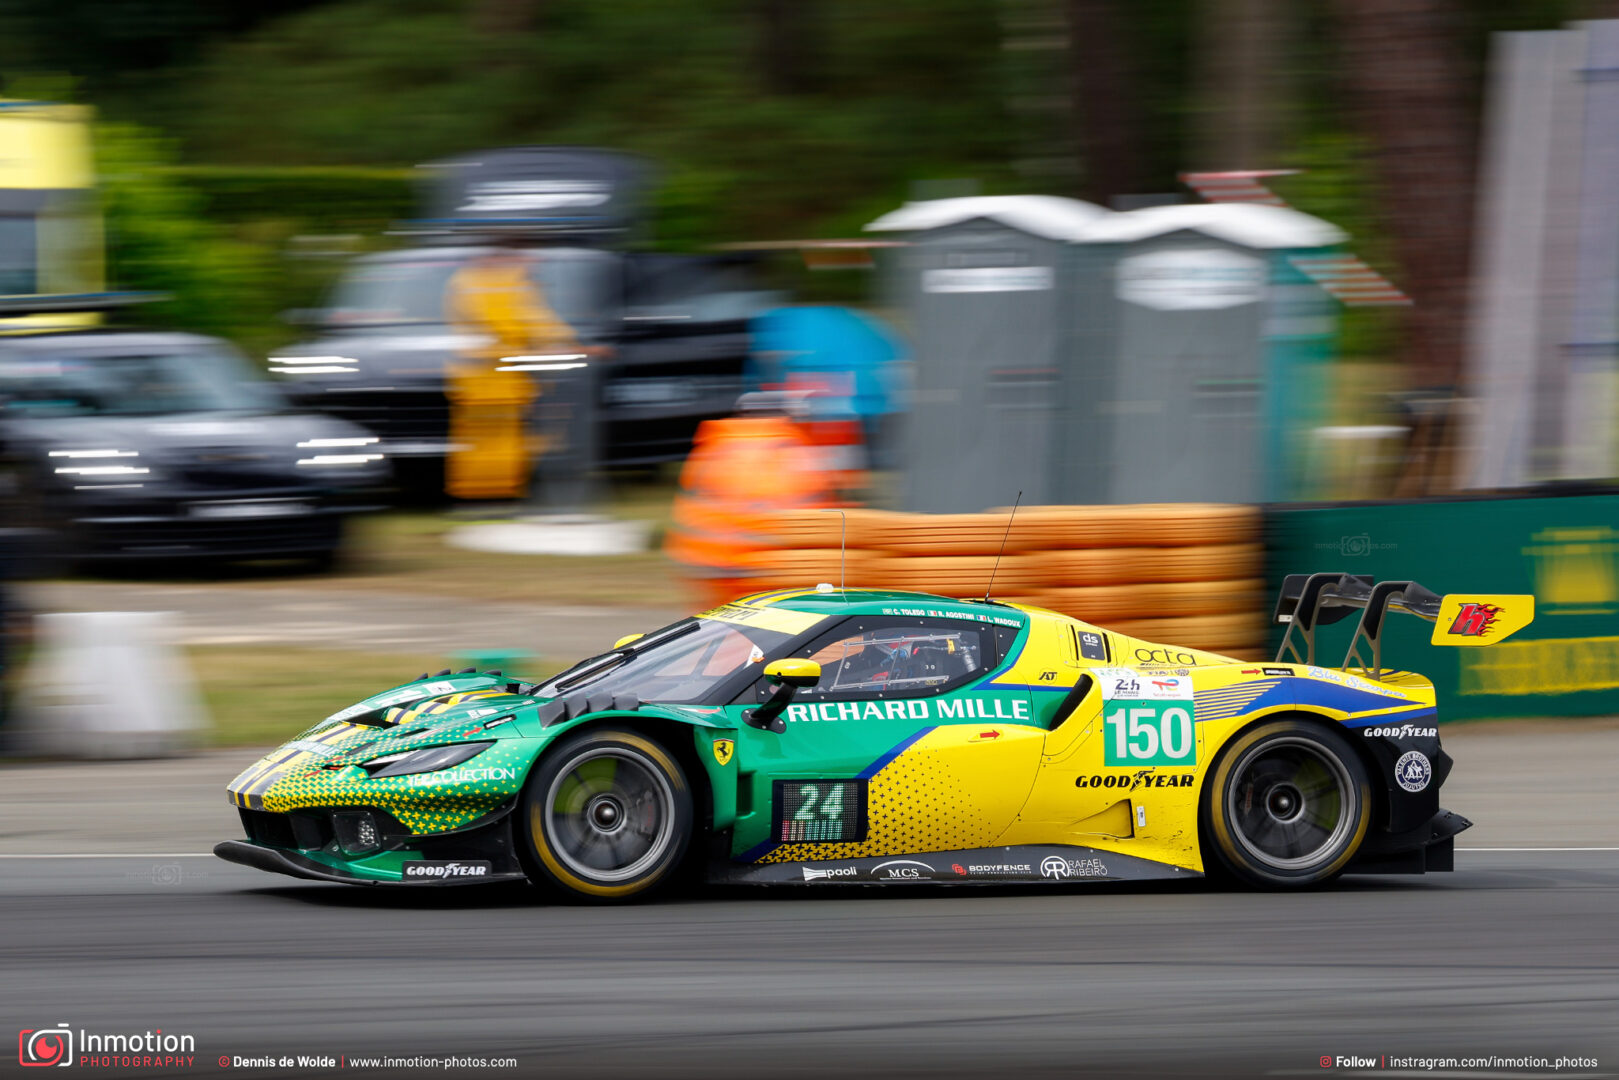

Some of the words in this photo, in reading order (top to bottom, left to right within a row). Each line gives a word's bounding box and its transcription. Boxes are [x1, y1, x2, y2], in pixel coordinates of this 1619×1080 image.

[893, 608, 901, 616] C.
[945, 611, 975, 620] AGOSTINI
[994, 617, 1021, 628] WADOUX
[1082, 633, 1099, 644] ds
[1134, 648, 1197, 666] octa
[787, 701, 930, 722] RICHARD
[937, 699, 1030, 721] MILLE
[1106, 707, 1193, 759] 150
[794, 782, 844, 820] 24
[968, 864, 1032, 872] BODYFENCE
[1068, 858, 1103, 869] RAFAEL
[826, 866, 858, 879] paoli
[888, 868, 920, 878] MCS
[1069, 867, 1108, 877] RIBEIRO
